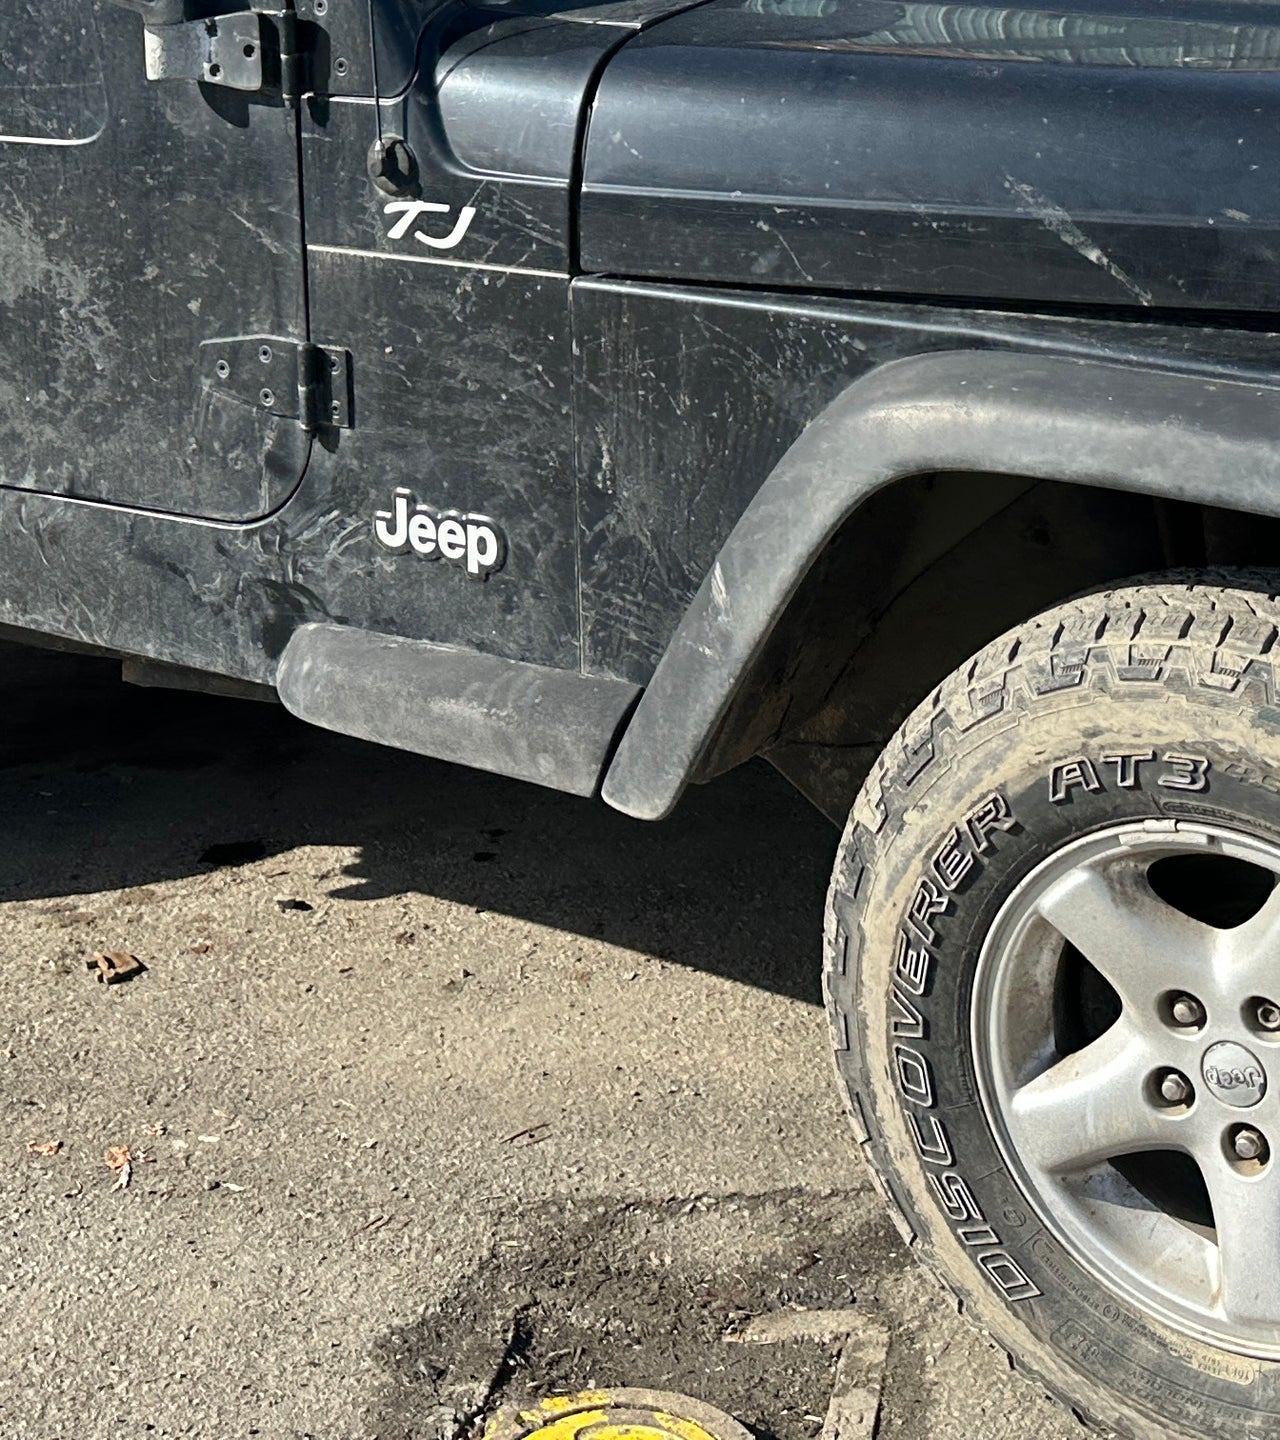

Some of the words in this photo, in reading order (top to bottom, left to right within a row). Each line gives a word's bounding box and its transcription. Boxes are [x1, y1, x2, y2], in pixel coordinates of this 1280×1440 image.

[383, 200, 476, 250] TJ
[374, 487, 503, 576] Jeep
[889, 791, 1043, 1303] DISCOVERER
[1048, 750, 1209, 803] AT3
[1205, 1065, 1262, 1090] Jeep
